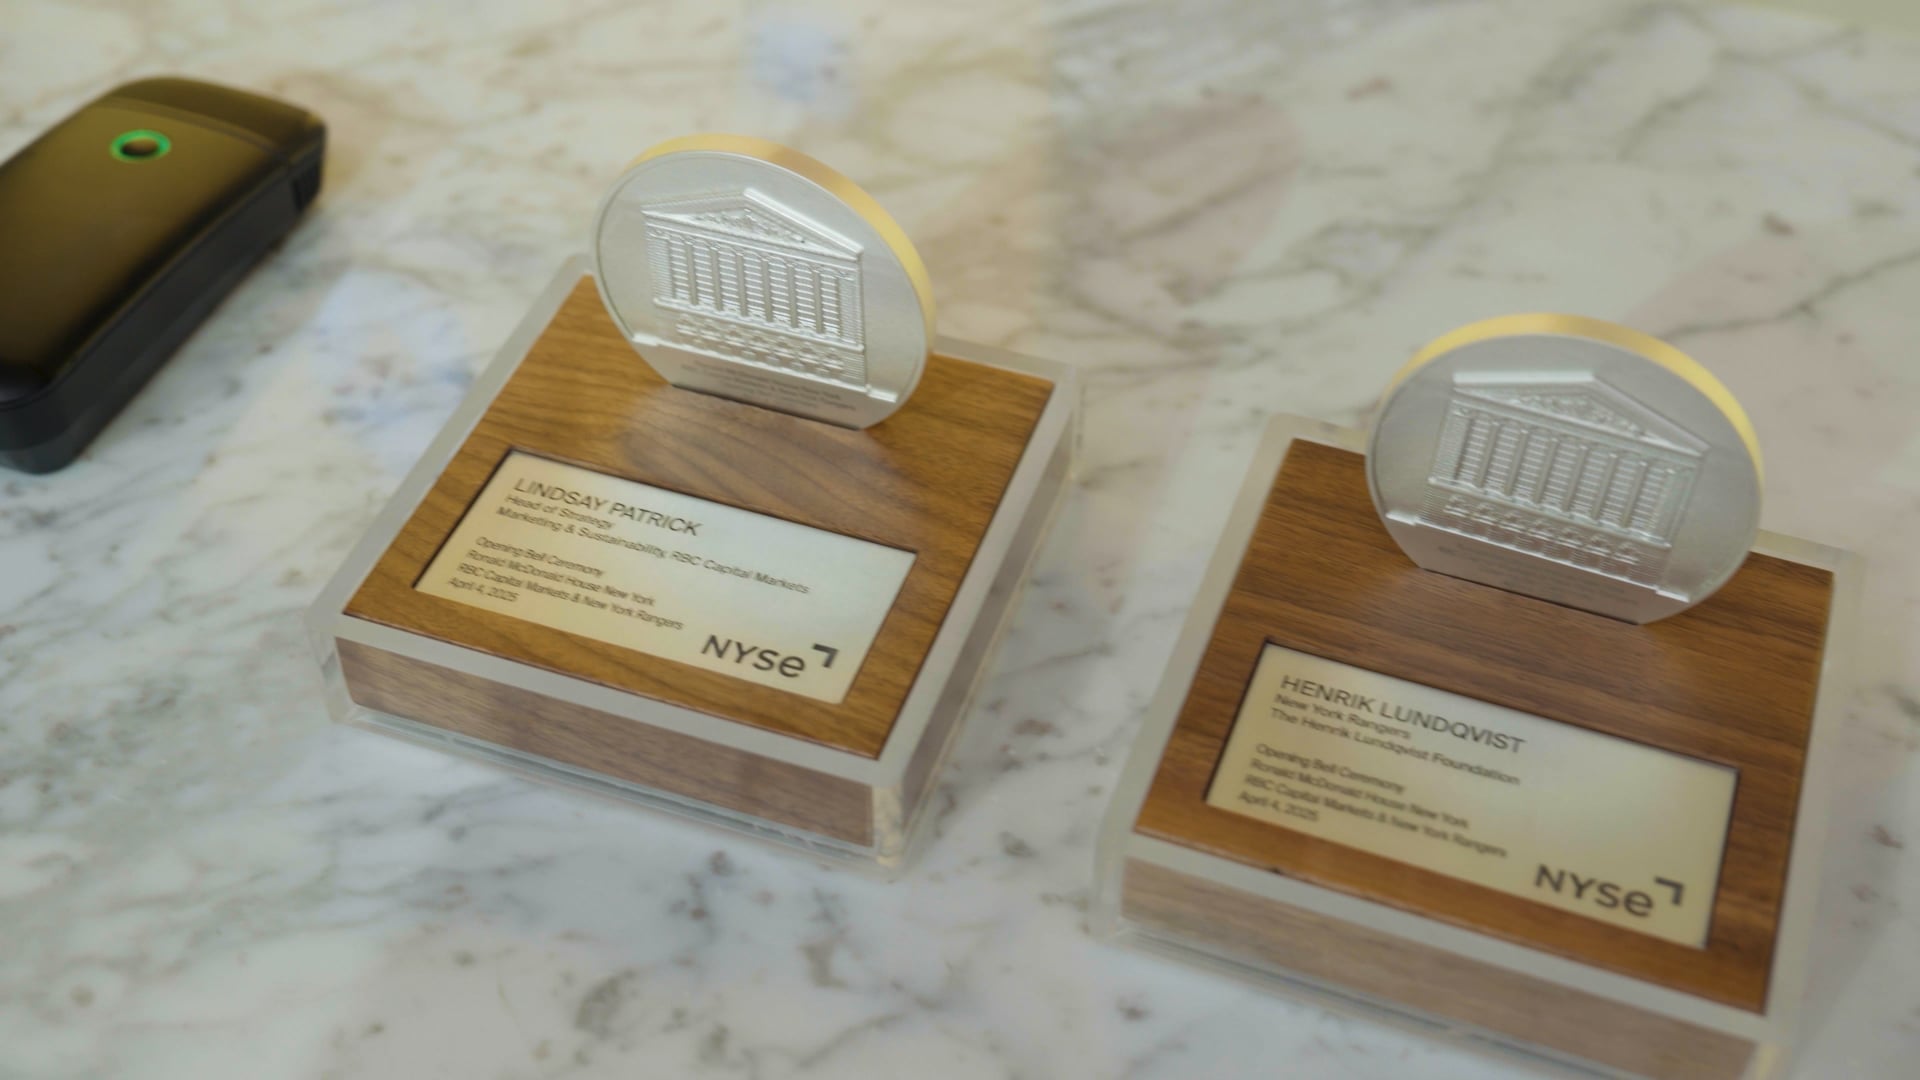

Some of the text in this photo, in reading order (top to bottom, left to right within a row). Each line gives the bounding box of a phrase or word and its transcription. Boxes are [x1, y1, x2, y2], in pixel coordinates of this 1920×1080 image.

[505, 496, 614, 530] Head of Strategy
[514, 478, 701, 536] LINDSAY PATRICK
[467, 550, 656, 606] Ronald McDonald House New York
[475, 536, 604, 577] Opening Bell Ceremony
[497, 506, 562, 533] Marketing
[565, 523, 576, 534] &
[672, 551, 701, 566] RBC
[703, 559, 751, 579] Capital
[753, 572, 809, 594] Markets
[449, 577, 474, 592] April
[457, 563, 685, 631] RBC Capital Markets & New York Rangers
[1275, 694, 1411, 740] New York Rangers
[1280, 674, 1526, 753] HENRIK LUNDQVIST
[1256, 743, 1310, 768] Opening
[1312, 758, 1337, 774] Bell
[1270, 707, 1520, 785] The Henrik Lundqvist Foundation
